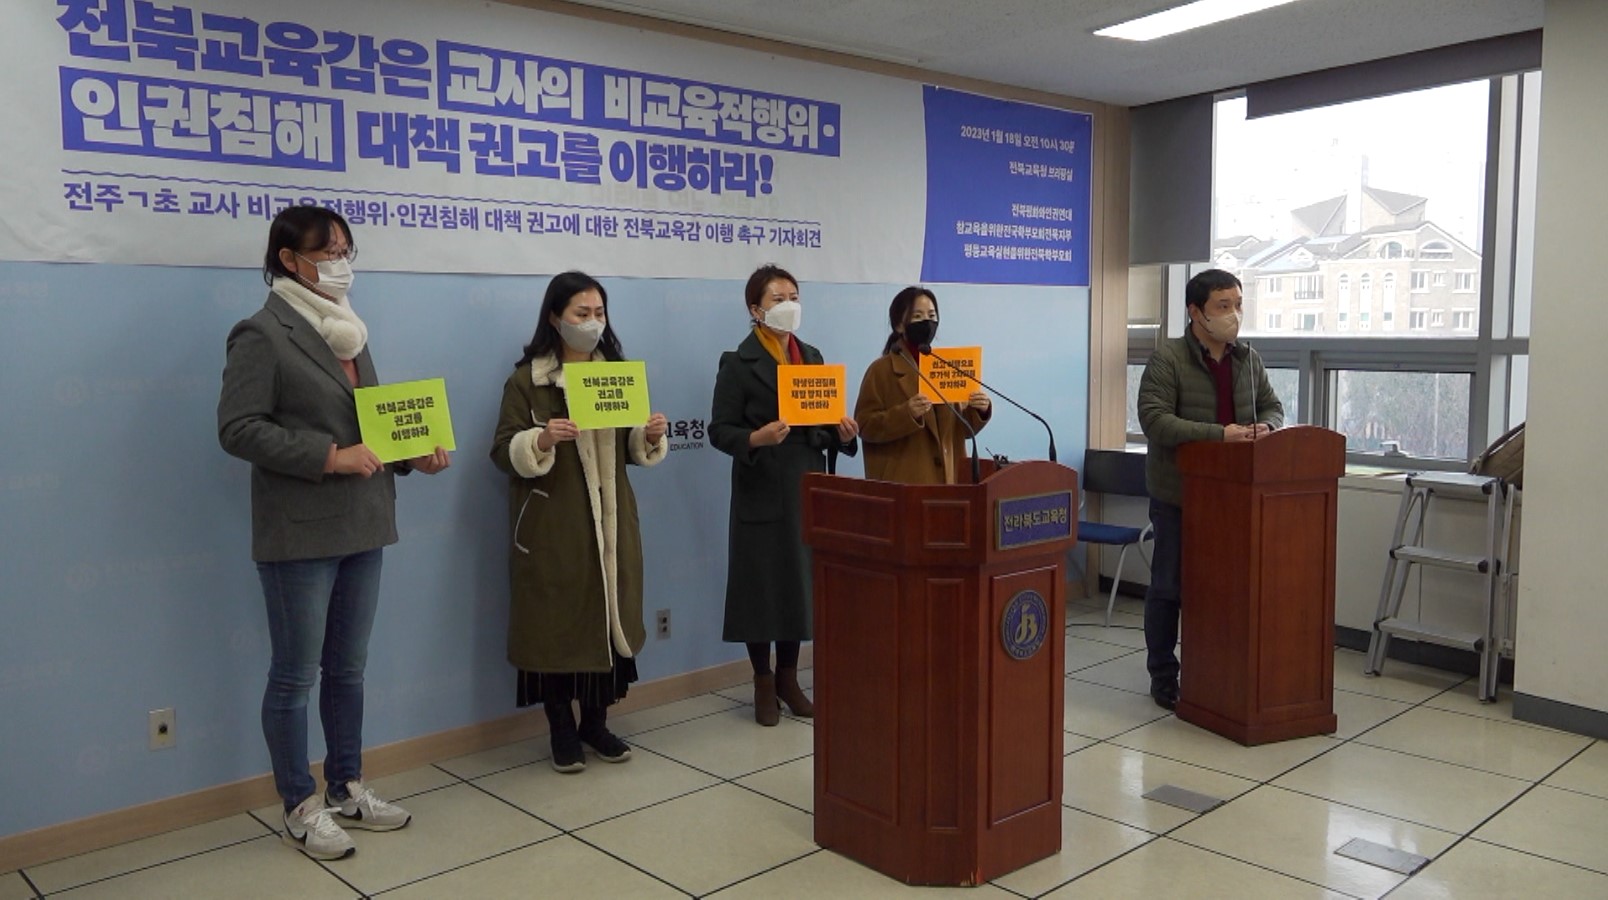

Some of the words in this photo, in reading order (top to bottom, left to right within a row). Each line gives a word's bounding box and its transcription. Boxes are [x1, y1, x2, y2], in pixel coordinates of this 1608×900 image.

[56, 0, 433, 99] 전북교육감은
[446, 51, 584, 120] 교사의
[604, 73, 836, 150] 비교육적행위·
[70, 76, 334, 163] 인권침해
[357, 111, 461, 174] 대책
[468, 120, 604, 186] 권고를
[608, 140, 775, 197] 이행하라!
[960, 125, 991, 142] 2023년
[991, 130, 1004, 144] 1월
[1005, 132, 1022, 147] 18일
[1023, 135, 1039, 149] 오전
[1040, 137, 1059, 152] 10시
[1059, 140, 1076, 154] 30분
[1009, 161, 1047, 177] 전북교육청
[1048, 167, 1073, 182] 브리핑실
[187, 190, 241, 219] 교사
[485, 208, 522, 233] 대책
[526, 211, 580, 236] 권고에
[586, 214, 619, 238] 대한
[623, 217, 701, 243] 전북교육감
[705, 223, 734, 243] 이행
[737, 225, 766, 246] 촉구
[769, 227, 822, 249] 기자회견
[582, 376, 635, 388] 전북교육감은
[597, 387, 624, 400] 권고를
[375, 396, 435, 415] 전북교육감은
[594, 400, 630, 412] 이행하라
[394, 412, 423, 427] 권고를
[391, 425, 430, 441] 이행하라
[1004, 507, 1067, 533] 전라북도교육청
